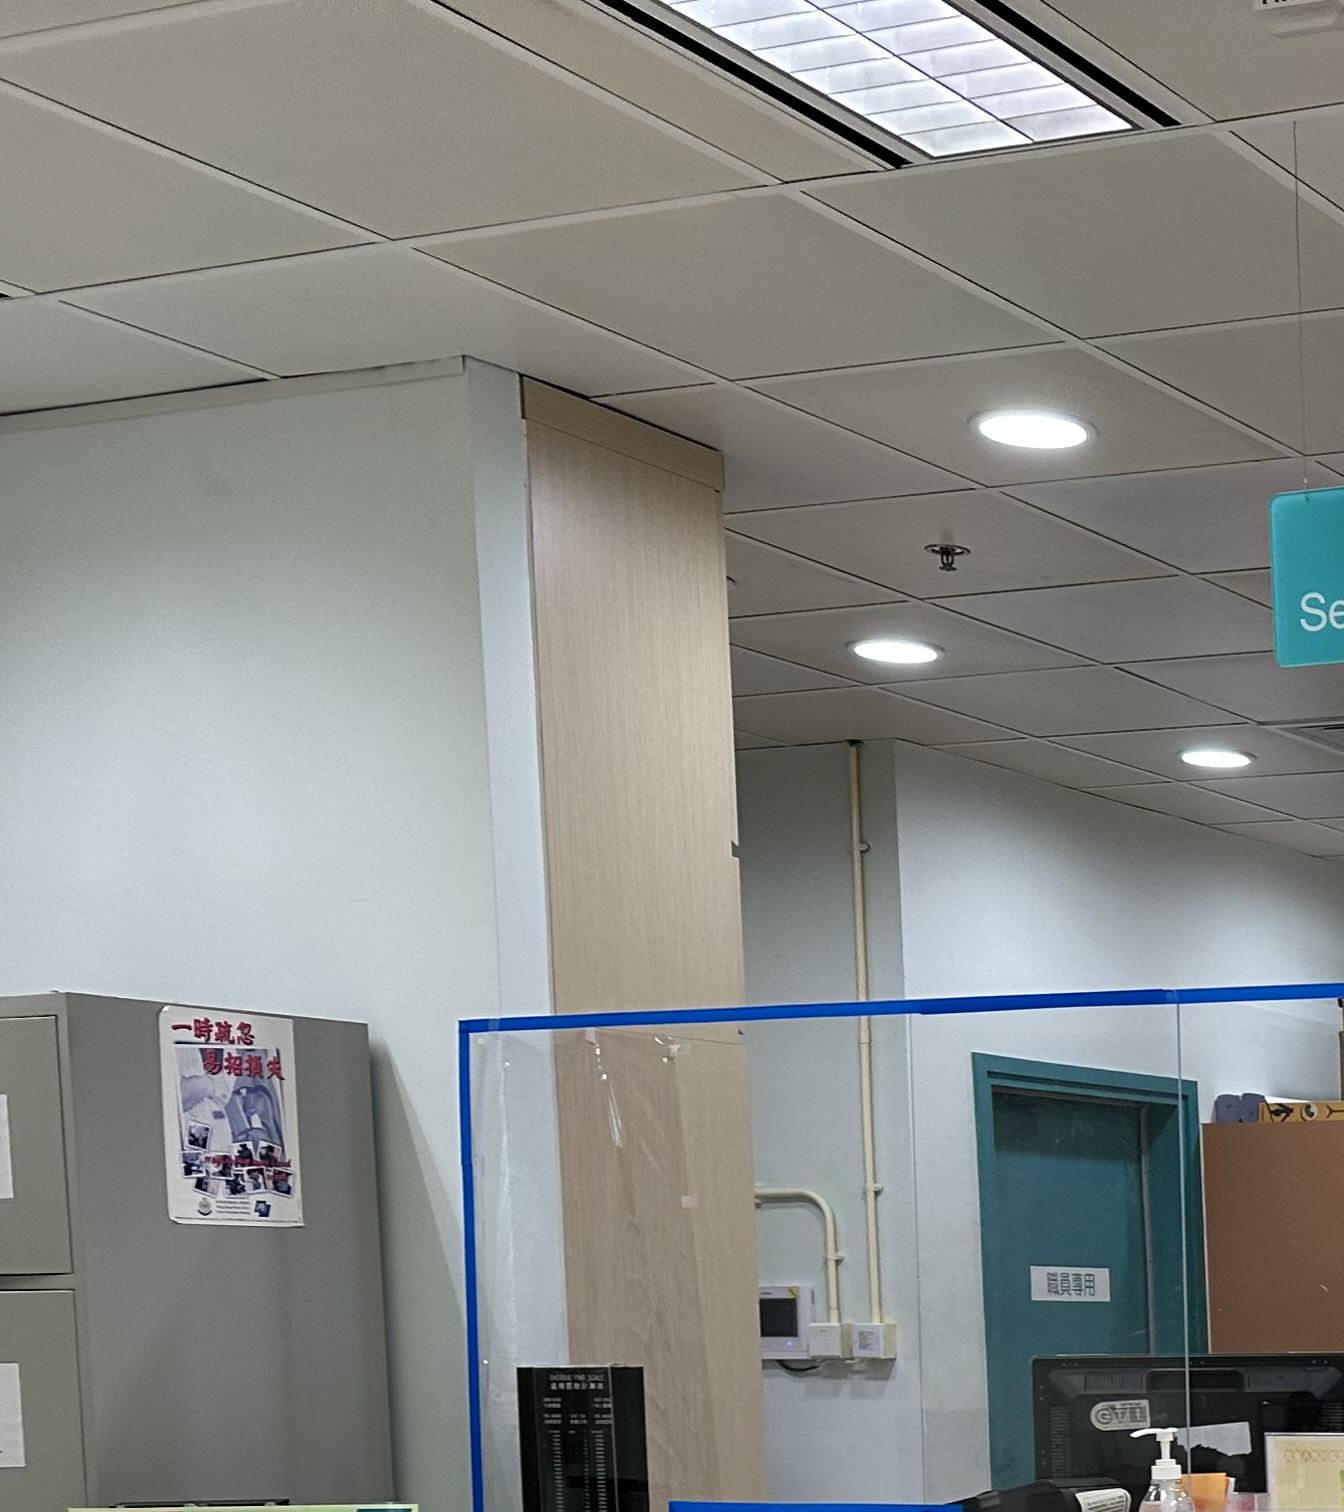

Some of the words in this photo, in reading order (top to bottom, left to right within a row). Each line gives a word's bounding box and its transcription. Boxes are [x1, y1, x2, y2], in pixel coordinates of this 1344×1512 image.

[171, 1018, 255, 1046] 一時疏忽
[204, 1049, 285, 1081] 易招損失
